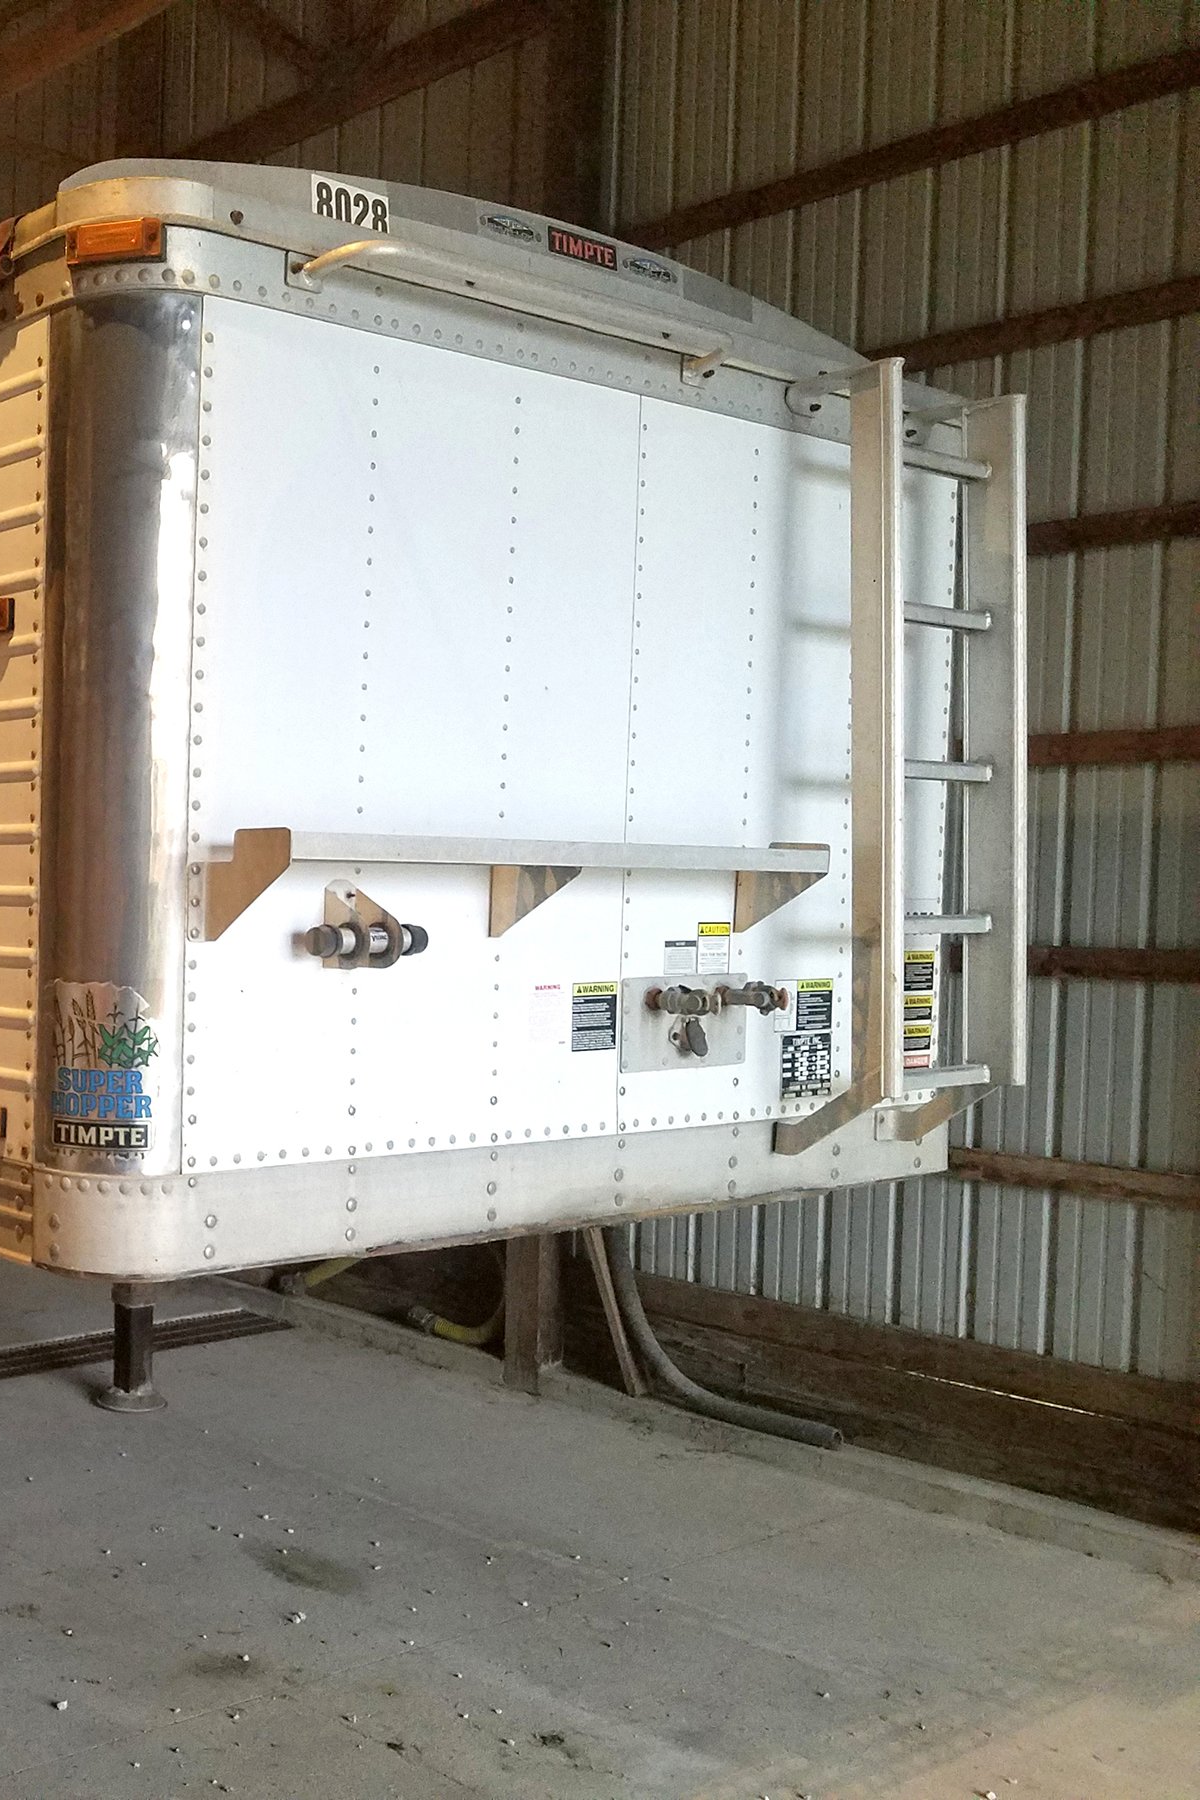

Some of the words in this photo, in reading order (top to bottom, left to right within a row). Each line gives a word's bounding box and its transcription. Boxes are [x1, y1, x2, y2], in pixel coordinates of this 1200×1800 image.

[316, 181, 388, 234] 8028
[551, 231, 615, 267] TIMPTE
[704, 925, 730, 934] CAUTION
[582, 984, 615, 994] WARNING
[805, 980, 831, 989] WARNING
[57, 1066, 143, 1094] SUPER
[51, 1090, 152, 1119] HOPPER
[57, 1123, 146, 1146] TIMPTE
